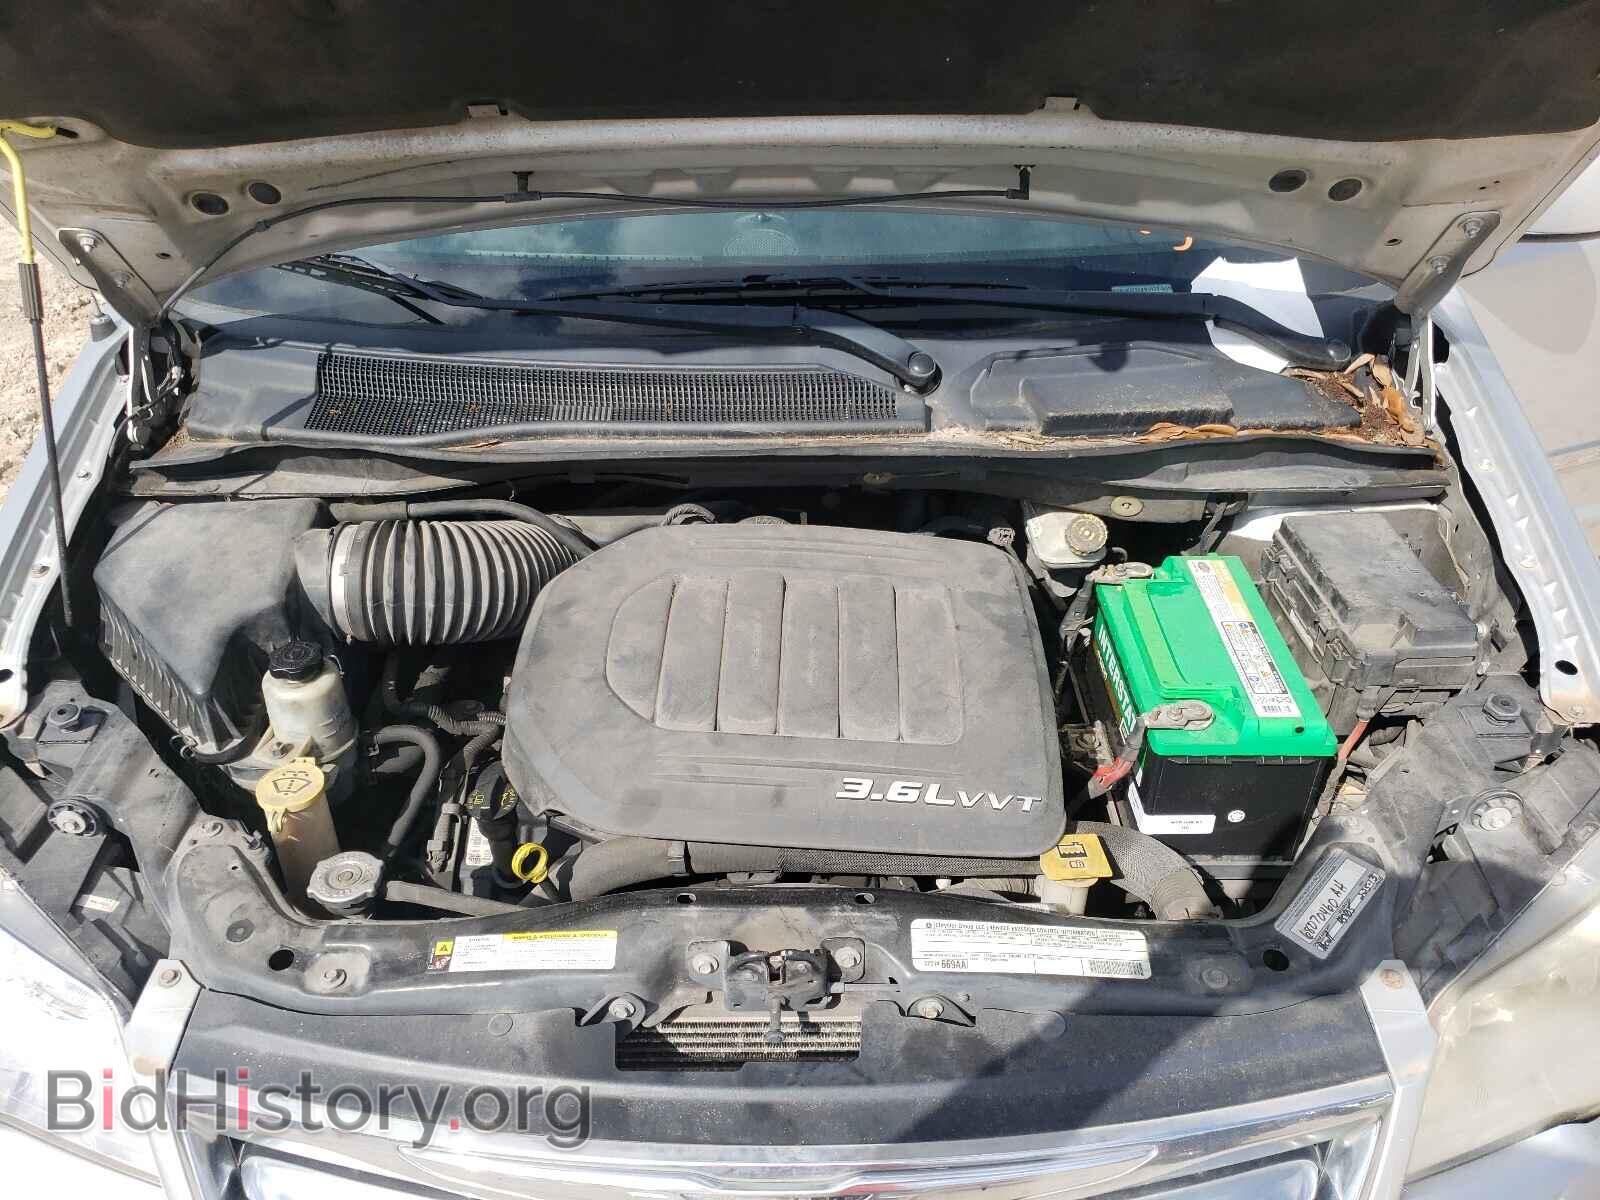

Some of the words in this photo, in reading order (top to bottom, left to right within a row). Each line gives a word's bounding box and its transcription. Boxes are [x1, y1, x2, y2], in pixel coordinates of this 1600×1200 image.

[1098, 623, 1137, 733] INTERSTAT
[835, 777, 955, 806] 3.6L
[957, 790, 1042, 813] VVT
